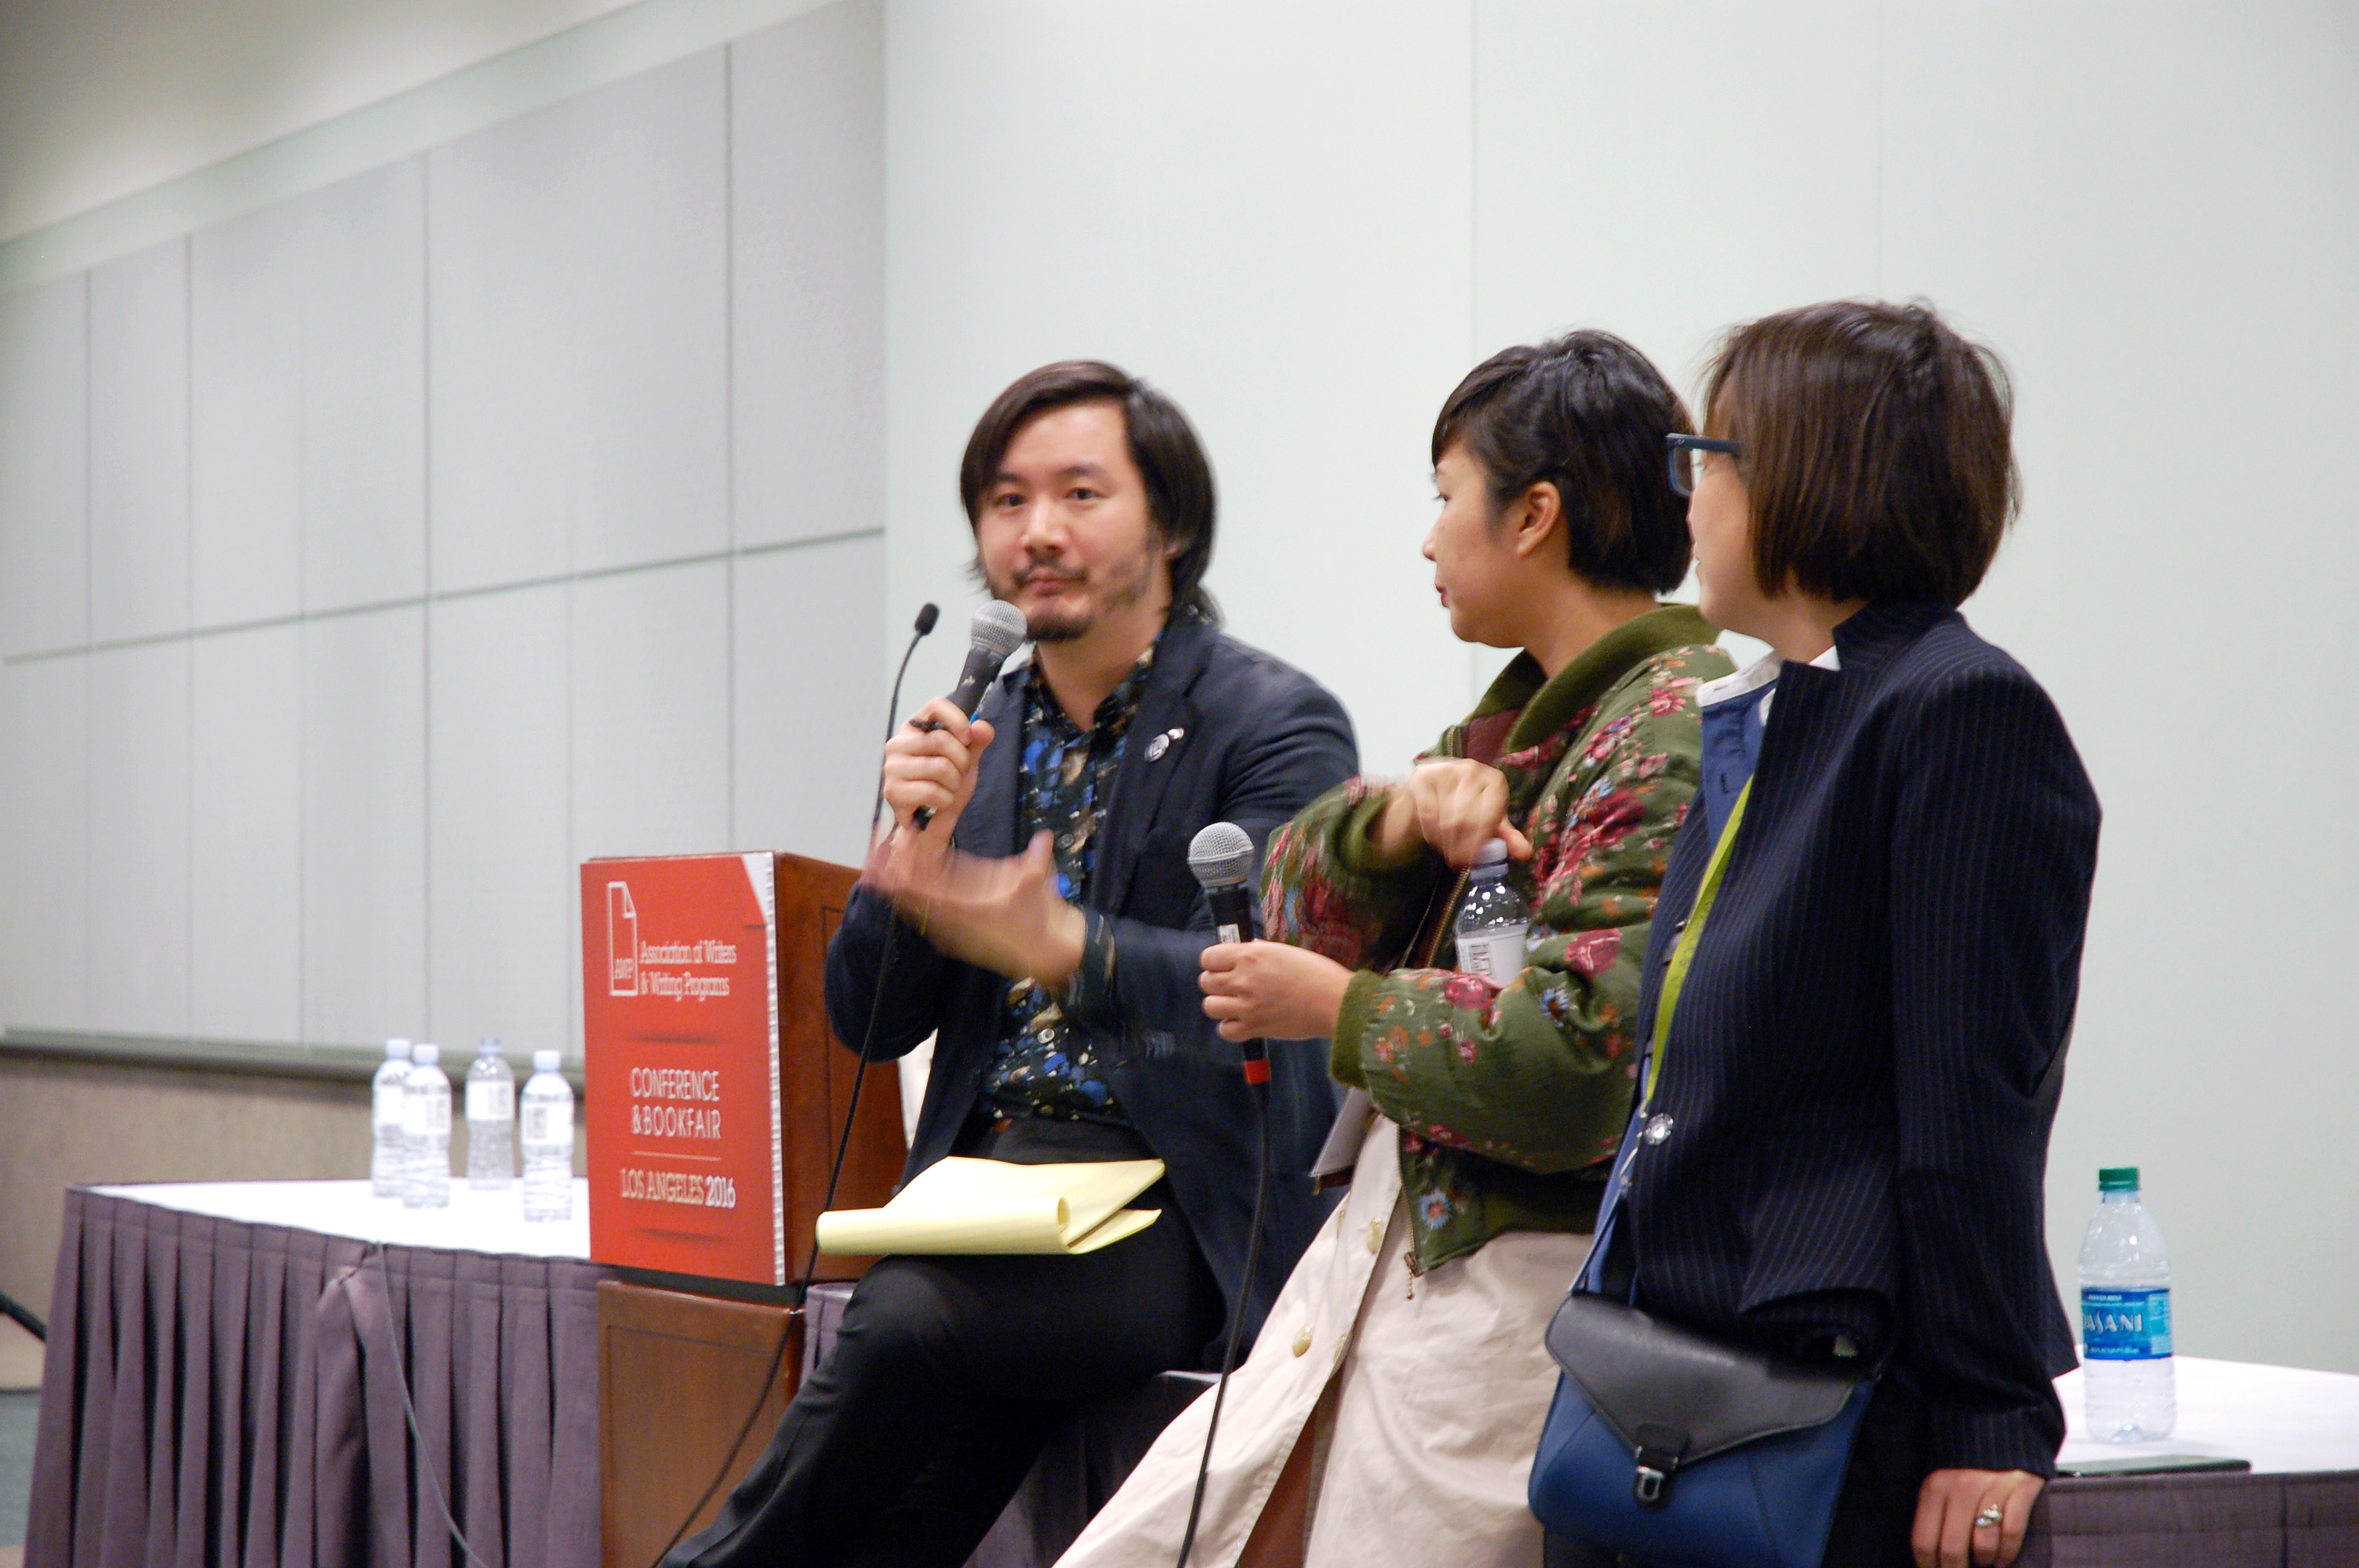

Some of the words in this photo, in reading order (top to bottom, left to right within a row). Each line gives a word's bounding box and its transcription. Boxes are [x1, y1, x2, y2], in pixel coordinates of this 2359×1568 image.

[639, 940, 692, 964] Association
[693, 940, 703, 964] of
[704, 939, 737, 964] Writers
[639, 971, 649, 995] &
[650, 971, 683, 1001] Writing
[684, 971, 730, 1001] Programs
[631, 1066, 720, 1102] CONFERENCE
[620, 1168, 645, 1199] LOS
[647, 1171, 705, 1205] ANGELES
[706, 1175, 737, 1209] 2016
